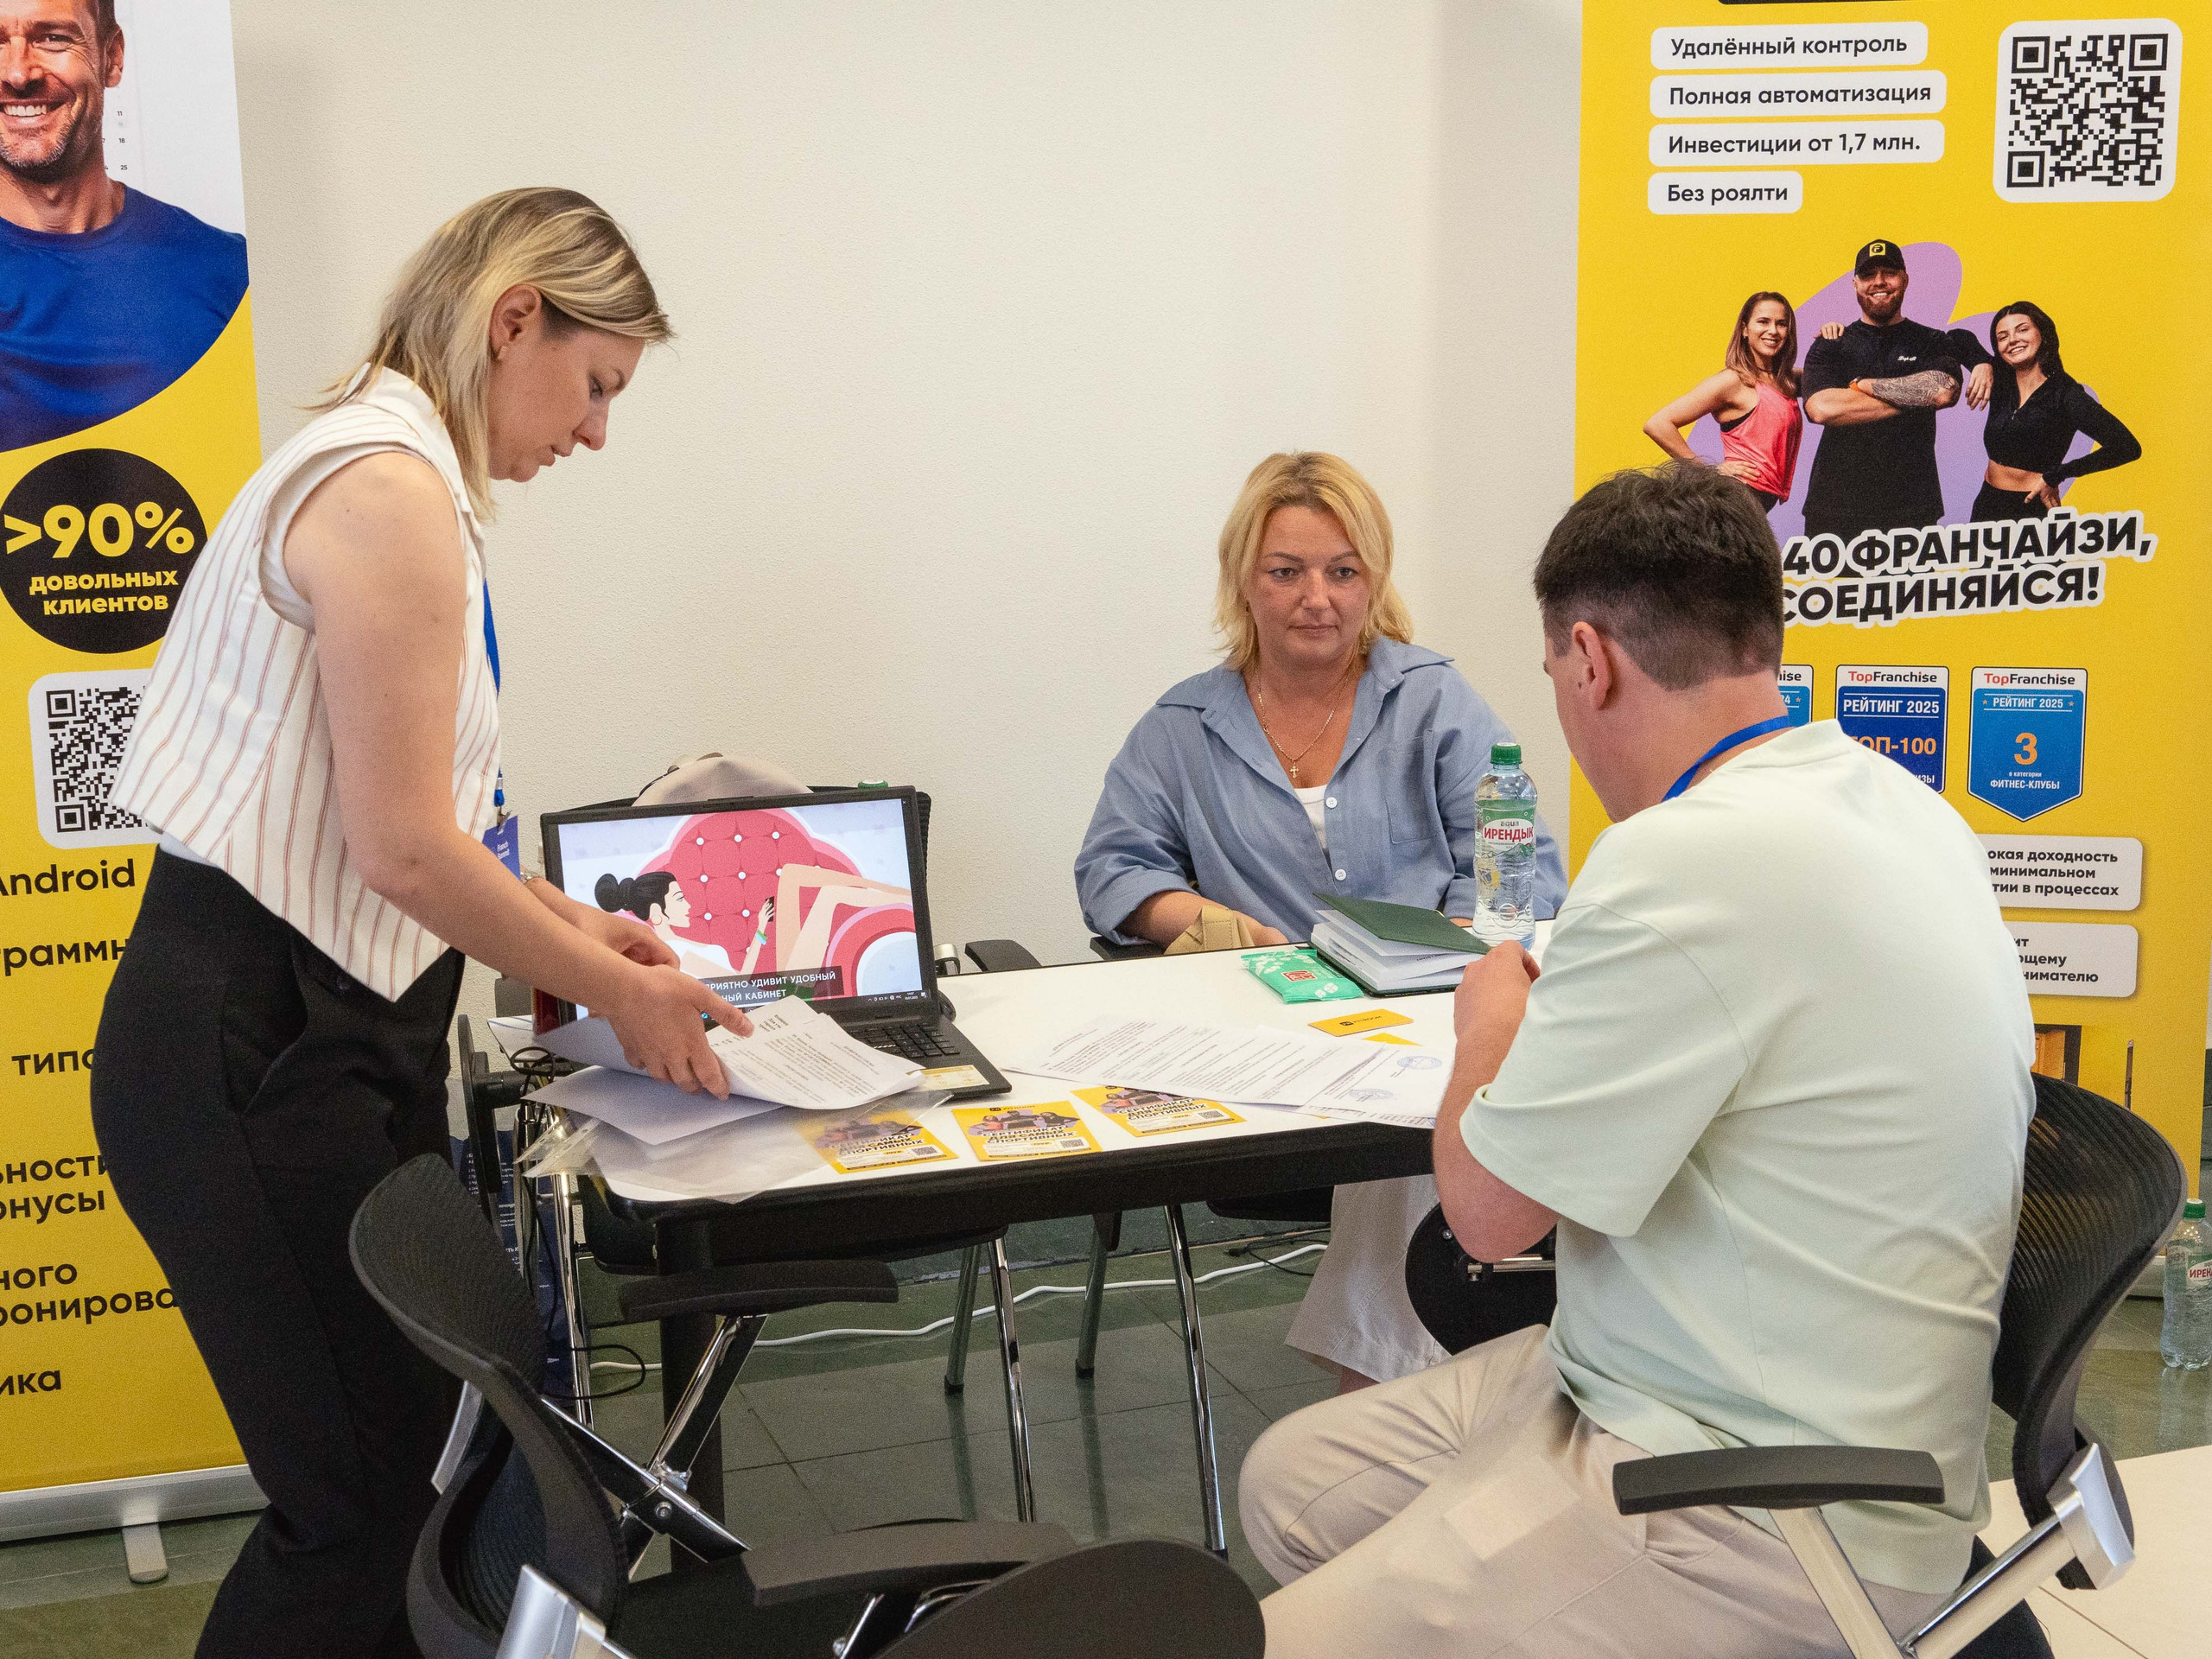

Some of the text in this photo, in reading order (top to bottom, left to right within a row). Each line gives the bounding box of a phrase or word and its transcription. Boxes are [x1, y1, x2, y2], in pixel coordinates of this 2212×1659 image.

[1670, 37, 1908, 59] Удалённый контроль
[1669, 86, 1932, 105] Полная автоматизация
[1669, 133, 1921, 155] Инвестиции от 1,7 млн.
[1668, 184, 1789, 206] Без роялти
[3, 501, 195, 558] >90%
[1783, 512, 2152, 575] 40 ФРАНЧАЙЗИ,
[29, 570, 179, 595] довольных
[44, 595, 169, 615] клиентов
[1843, 696, 1940, 714] РЕЙТИНГ 2025
[1993, 696, 2063, 708] РЕЙТИНГ 2025
[2014, 732, 2038, 766] 3
[1990, 779, 2060, 790] ФИТНЕС-КЛУБЫ
[1484, 826, 1534, 842] ИРЕНДЫК
[1986, 850, 2118, 863] окая доходность
[1989, 867, 2095, 878] минимальном
[2022, 884, 2031, 893] в
[2035, 885, 2120, 896] процессах
[0, 938, 129, 976] раммн
[751, 976, 787, 988] УДИВИТ
[790, 970, 836, 984] УДОБНЫЙ
[745, 989, 786, 1001] КАБИНЕТ
[0, 1191, 105, 1224] нусы
[2189, 1268, 2212, 1278] ИРЕН
